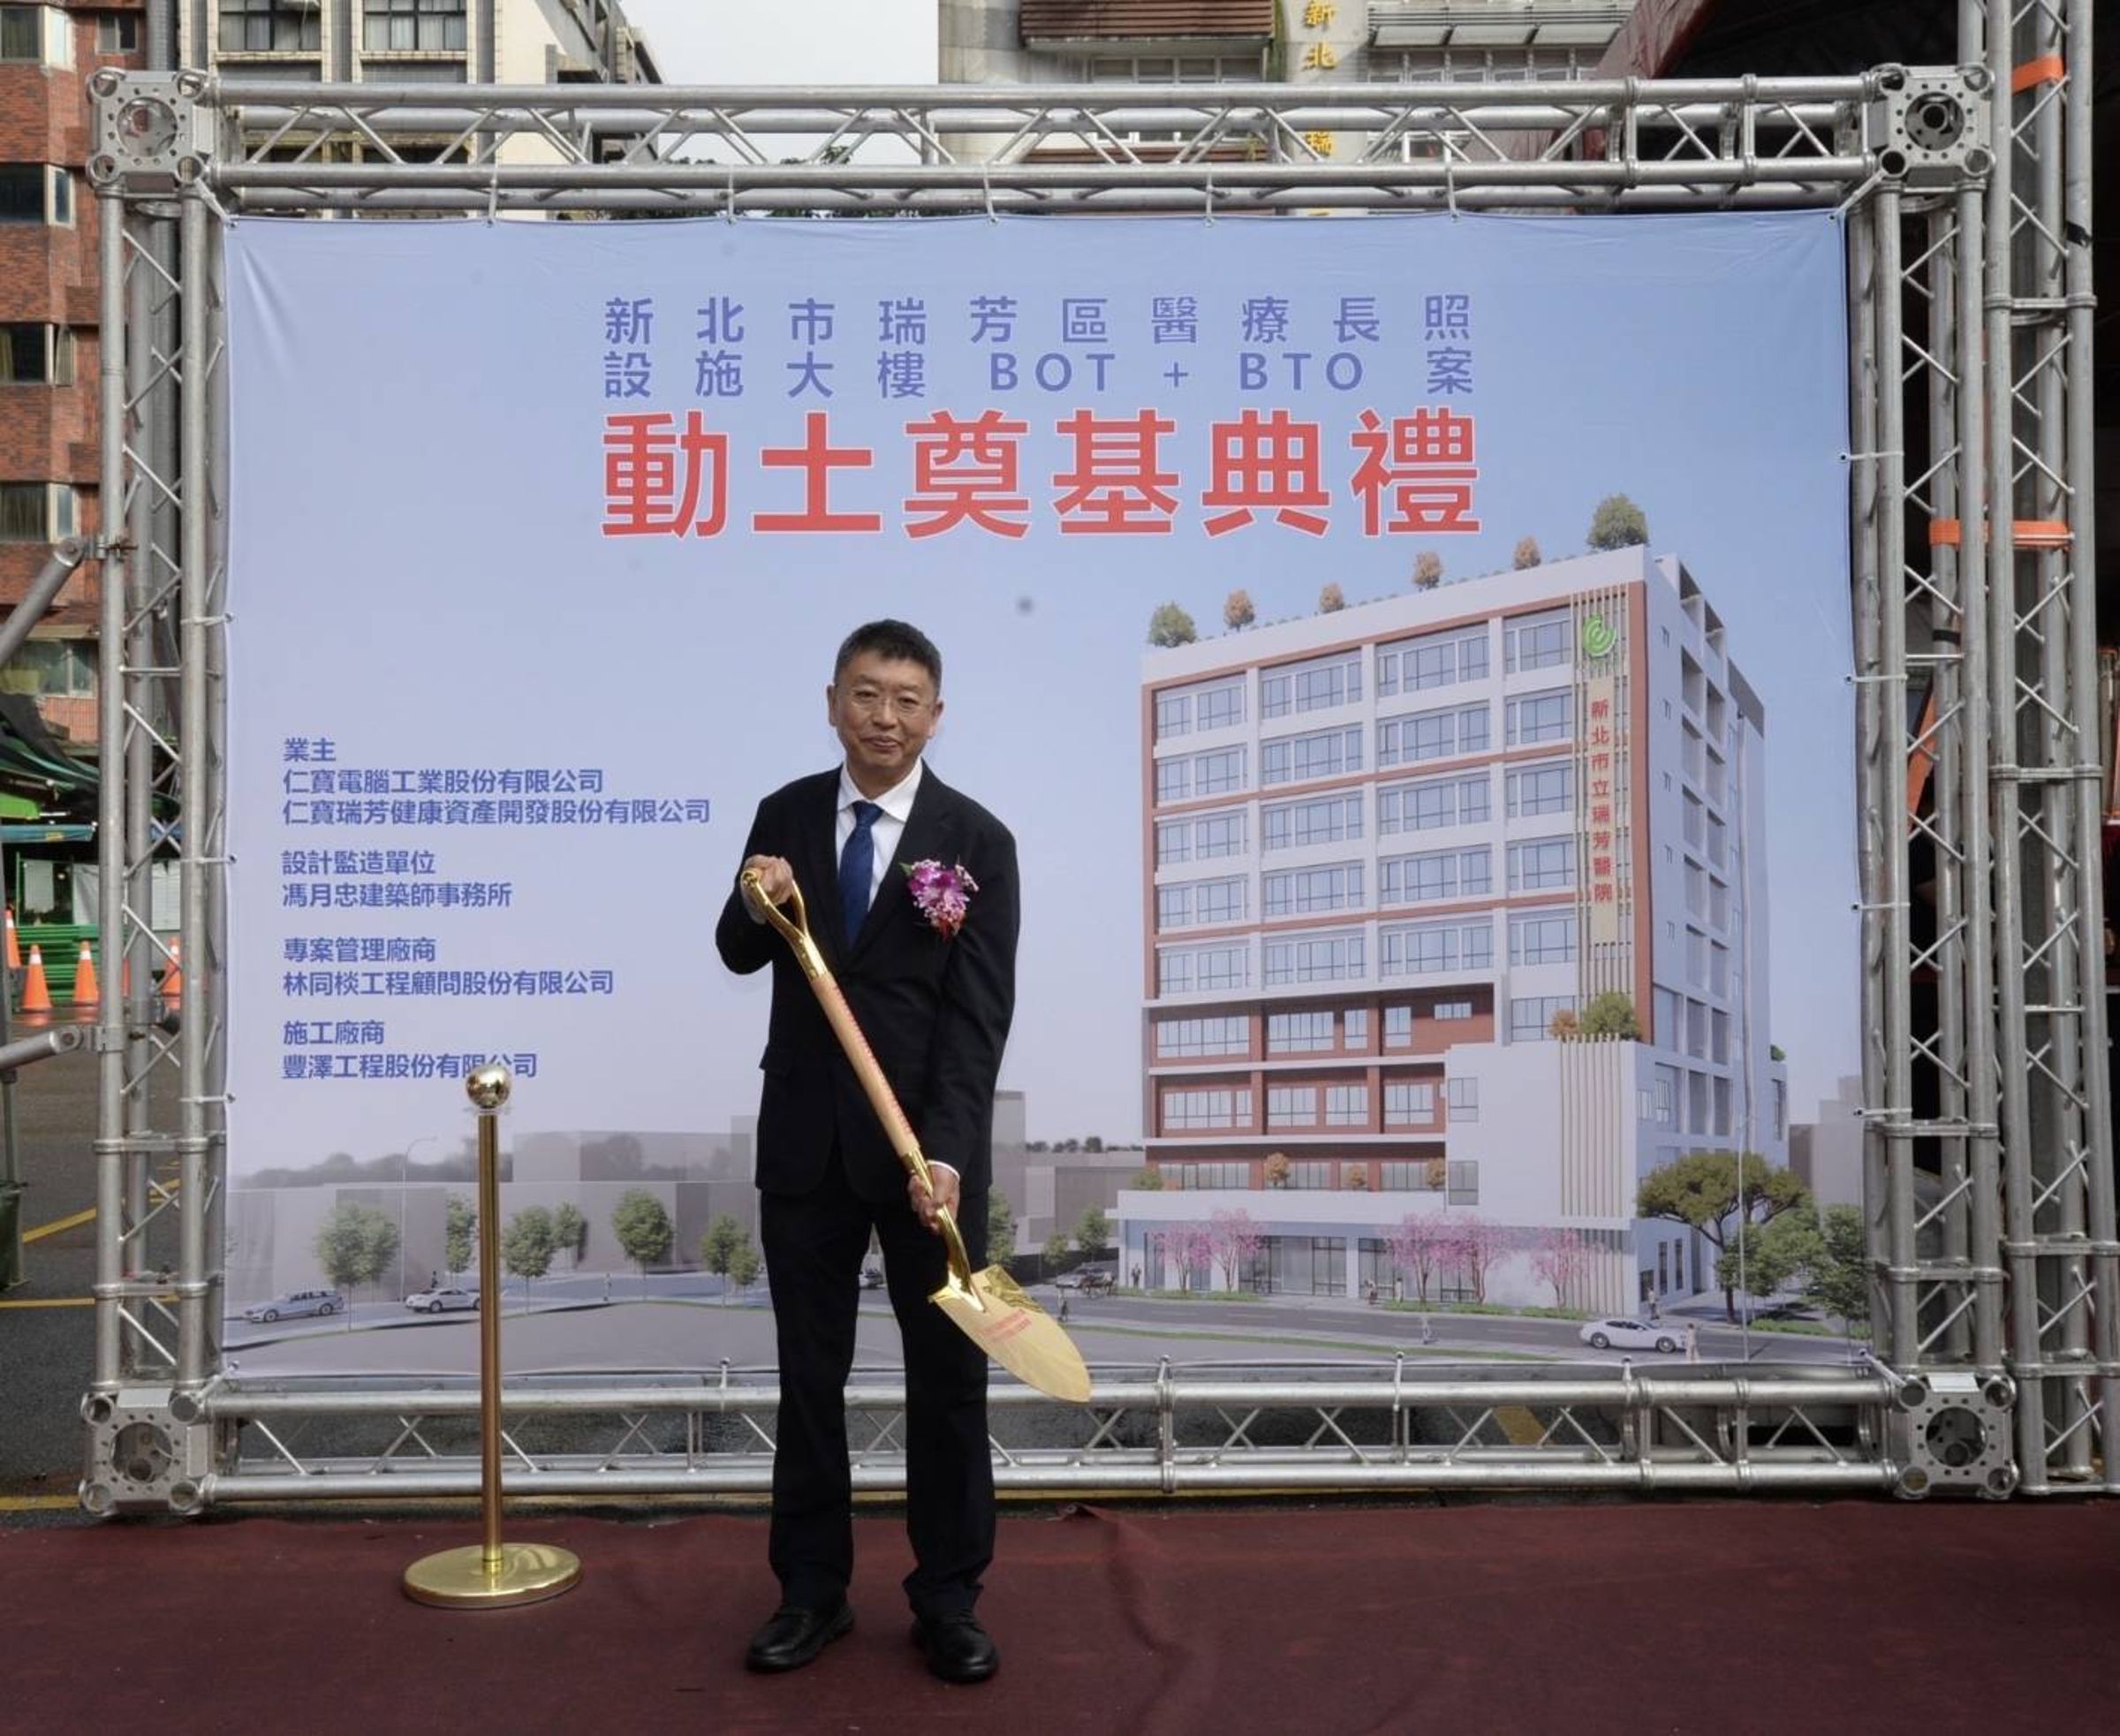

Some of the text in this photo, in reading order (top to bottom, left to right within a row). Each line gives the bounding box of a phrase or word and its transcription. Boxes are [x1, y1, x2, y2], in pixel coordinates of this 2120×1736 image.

[604, 294, 1470, 345] 新北市瑞芳區醫療長照
[603, 350, 1473, 398] 設施大樓 BOT + BTO 案
[602, 406, 1481, 538] 動土奠基典禮
[283, 737, 337, 762] 業主
[283, 768, 603, 794] 仁寶電腦工業股份有限公司
[283, 799, 710, 824] 仁寶瑞芳健康資產開發股份有限公司
[1591, 700, 1612, 902] 新北市立瑞芳醫院
[281, 849, 436, 876] 設計監造單位
[282, 881, 513, 908] 馮月忠建築師事務所
[284, 936, 436, 964] 專案管理廠商
[283, 969, 614, 997] 林同棪工程顧問股份有限公司
[283, 1020, 385, 1046] 施工廠商
